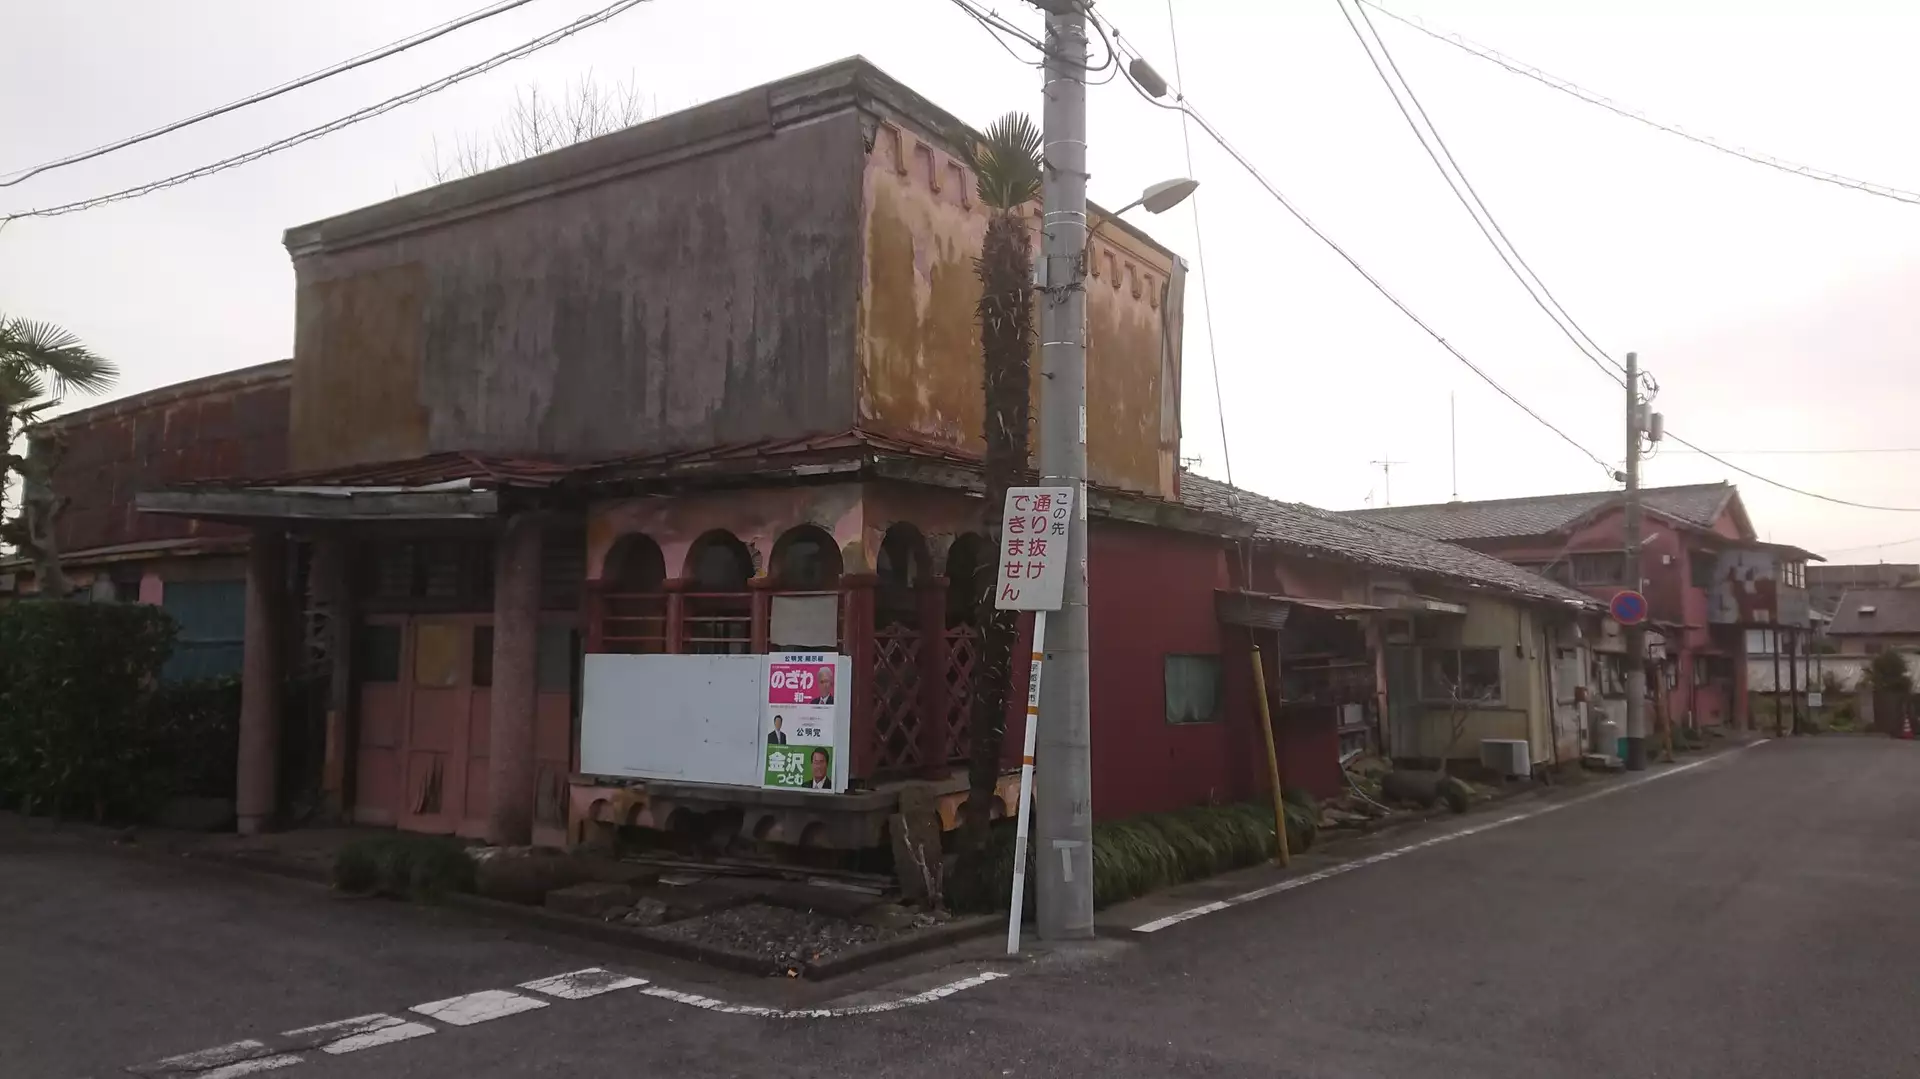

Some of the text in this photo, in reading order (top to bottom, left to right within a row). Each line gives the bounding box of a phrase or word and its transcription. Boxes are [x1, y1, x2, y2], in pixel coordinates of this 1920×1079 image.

[1051, 493, 1067, 535] この先
[1026, 494, 1051, 579] 通り抜け
[1001, 495, 1030, 601] できません
[771, 670, 814, 690] のざわ
[794, 692, 812, 703] 和一
[796, 727, 821, 738] 公明党
[768, 751, 805, 773] 金沢
[777, 773, 804, 785] つとむ
